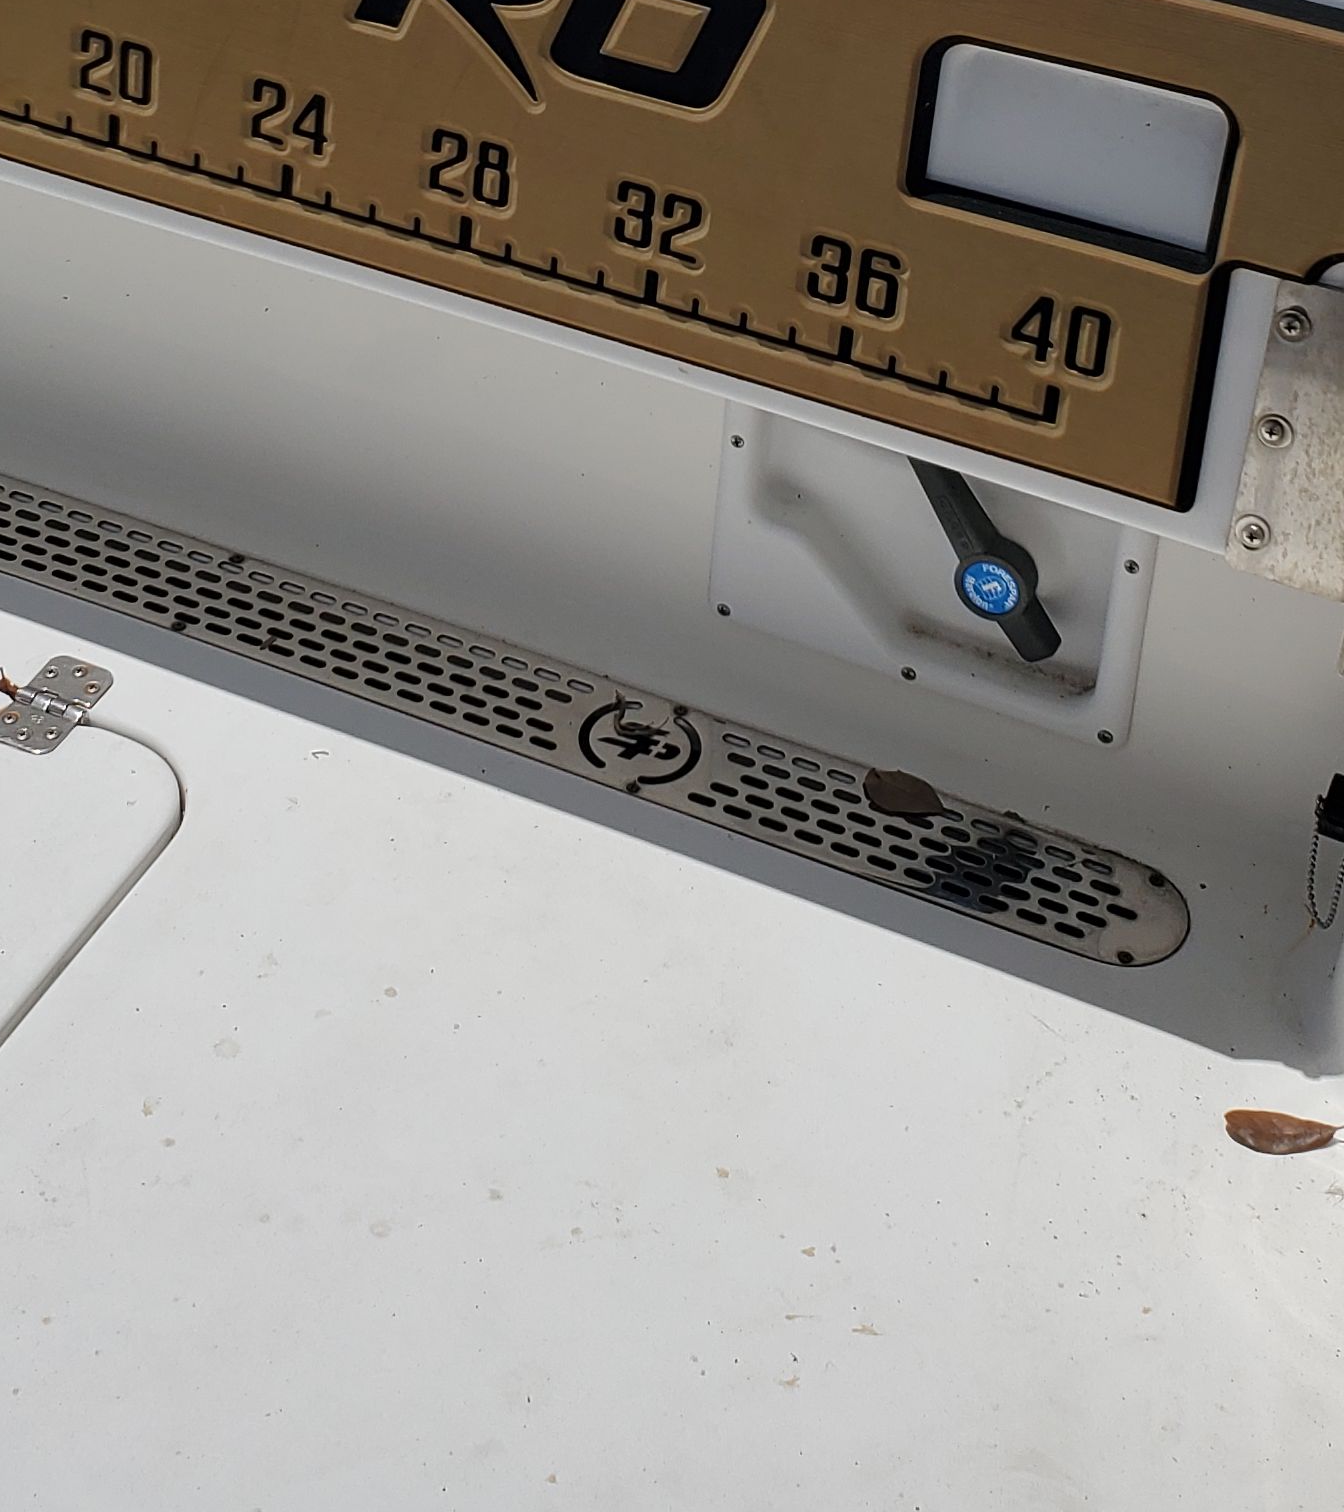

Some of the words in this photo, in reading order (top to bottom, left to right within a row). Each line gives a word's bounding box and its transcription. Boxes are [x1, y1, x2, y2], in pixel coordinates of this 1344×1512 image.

[79, 29, 154, 107] 20
[252, 78, 329, 156] 24
[431, 128, 510, 209] 28
[614, 180, 704, 267] 32
[807, 235, 902, 320] 36
[1011, 296, 1113, 378] 40
